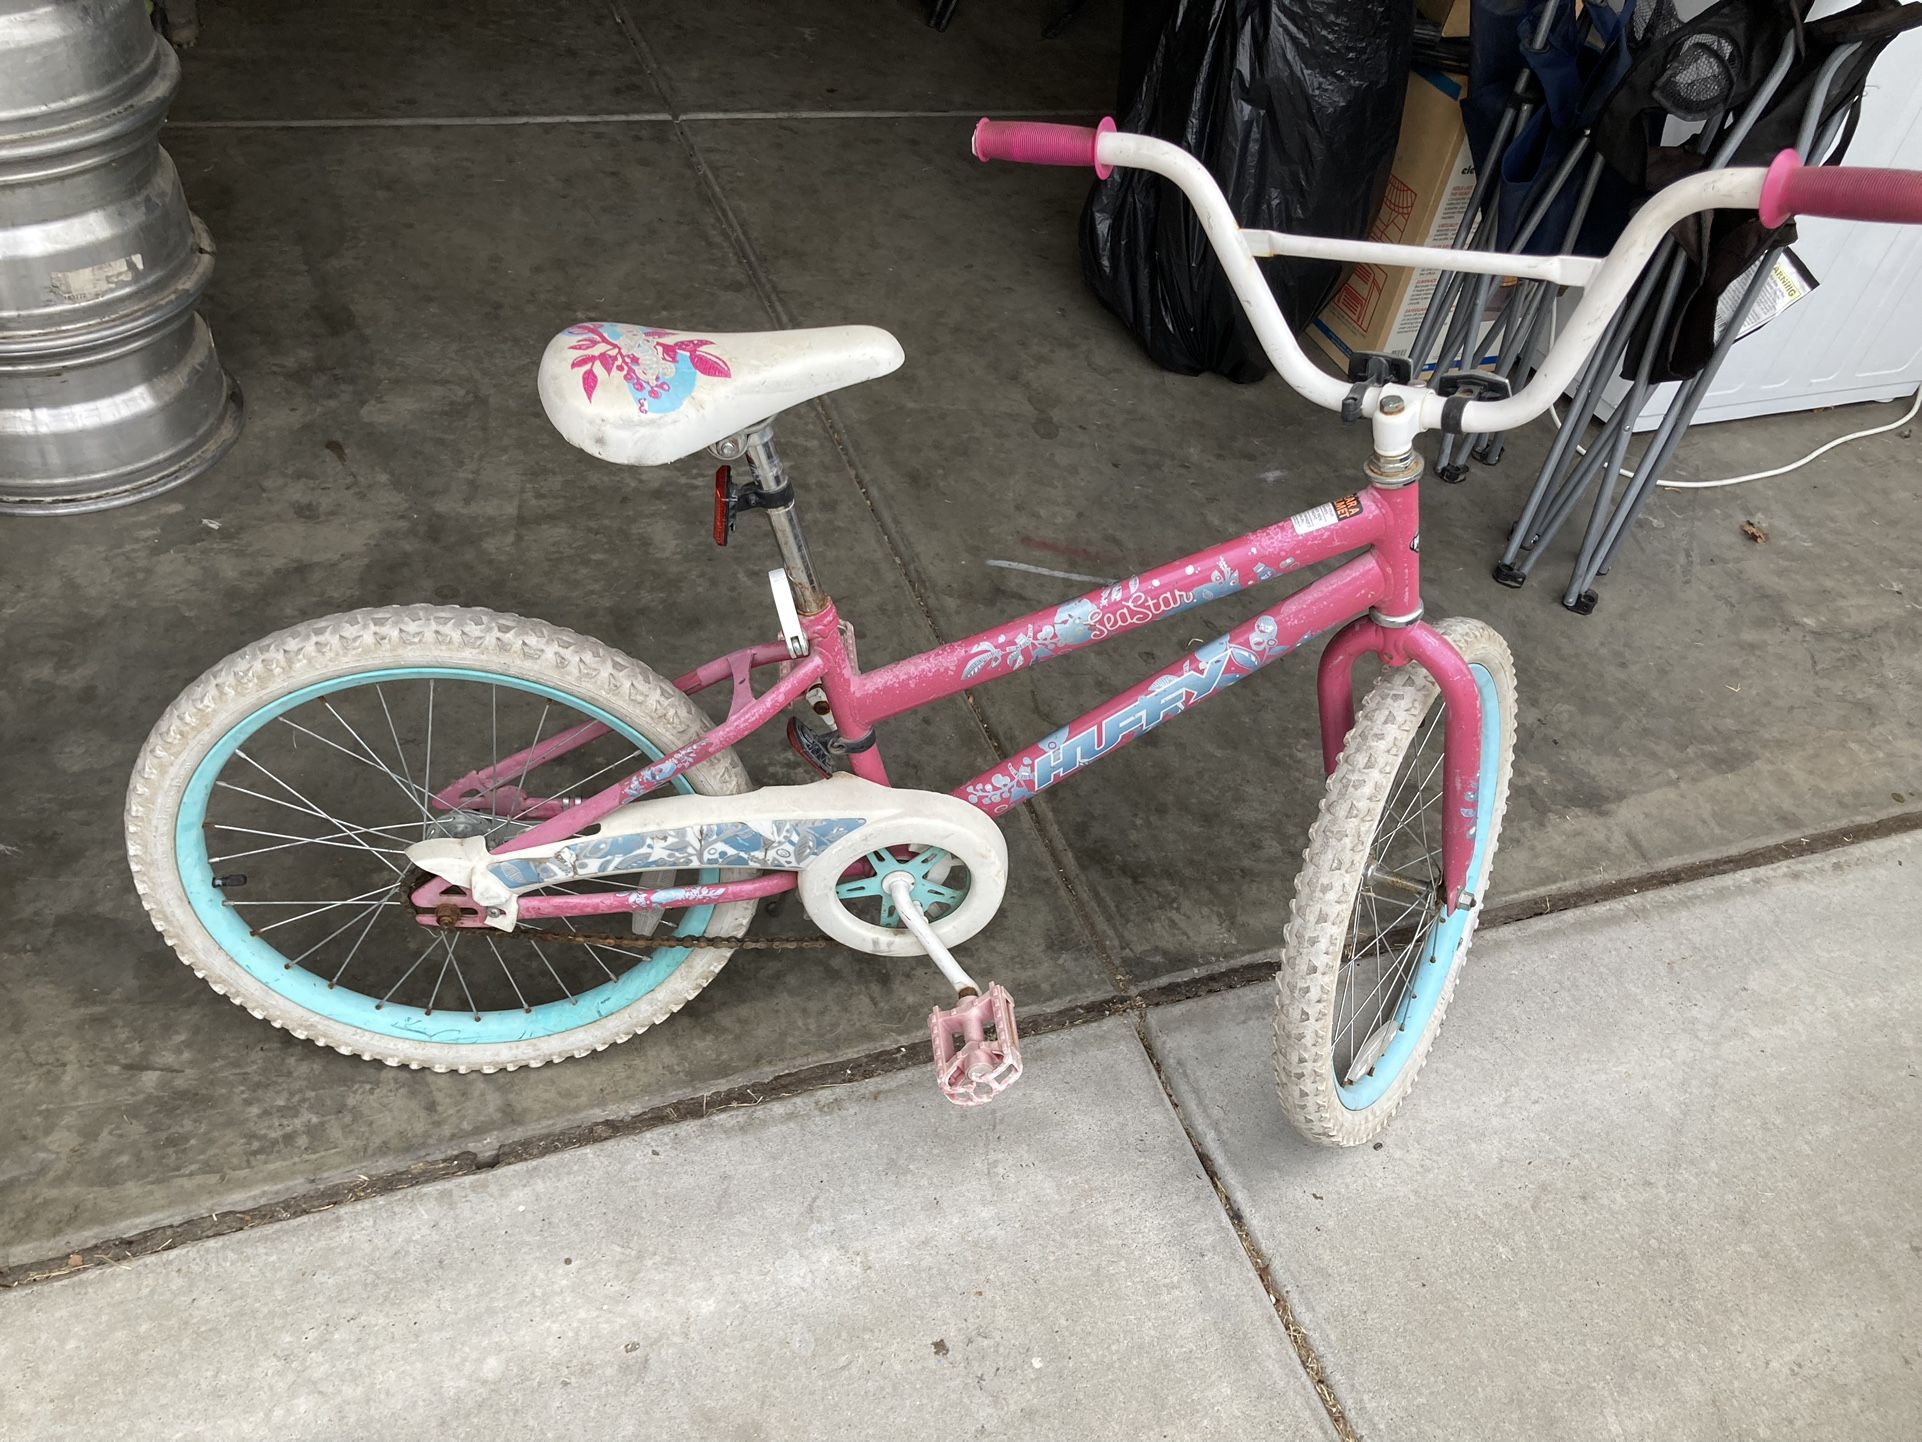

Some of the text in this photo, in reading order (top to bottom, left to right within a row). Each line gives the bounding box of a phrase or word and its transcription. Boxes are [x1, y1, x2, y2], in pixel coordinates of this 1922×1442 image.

[1773, 265, 1797, 298] ARNING
[1084, 589, 1194, 640] SeaStar
[1034, 648, 1234, 792] HUFFY
